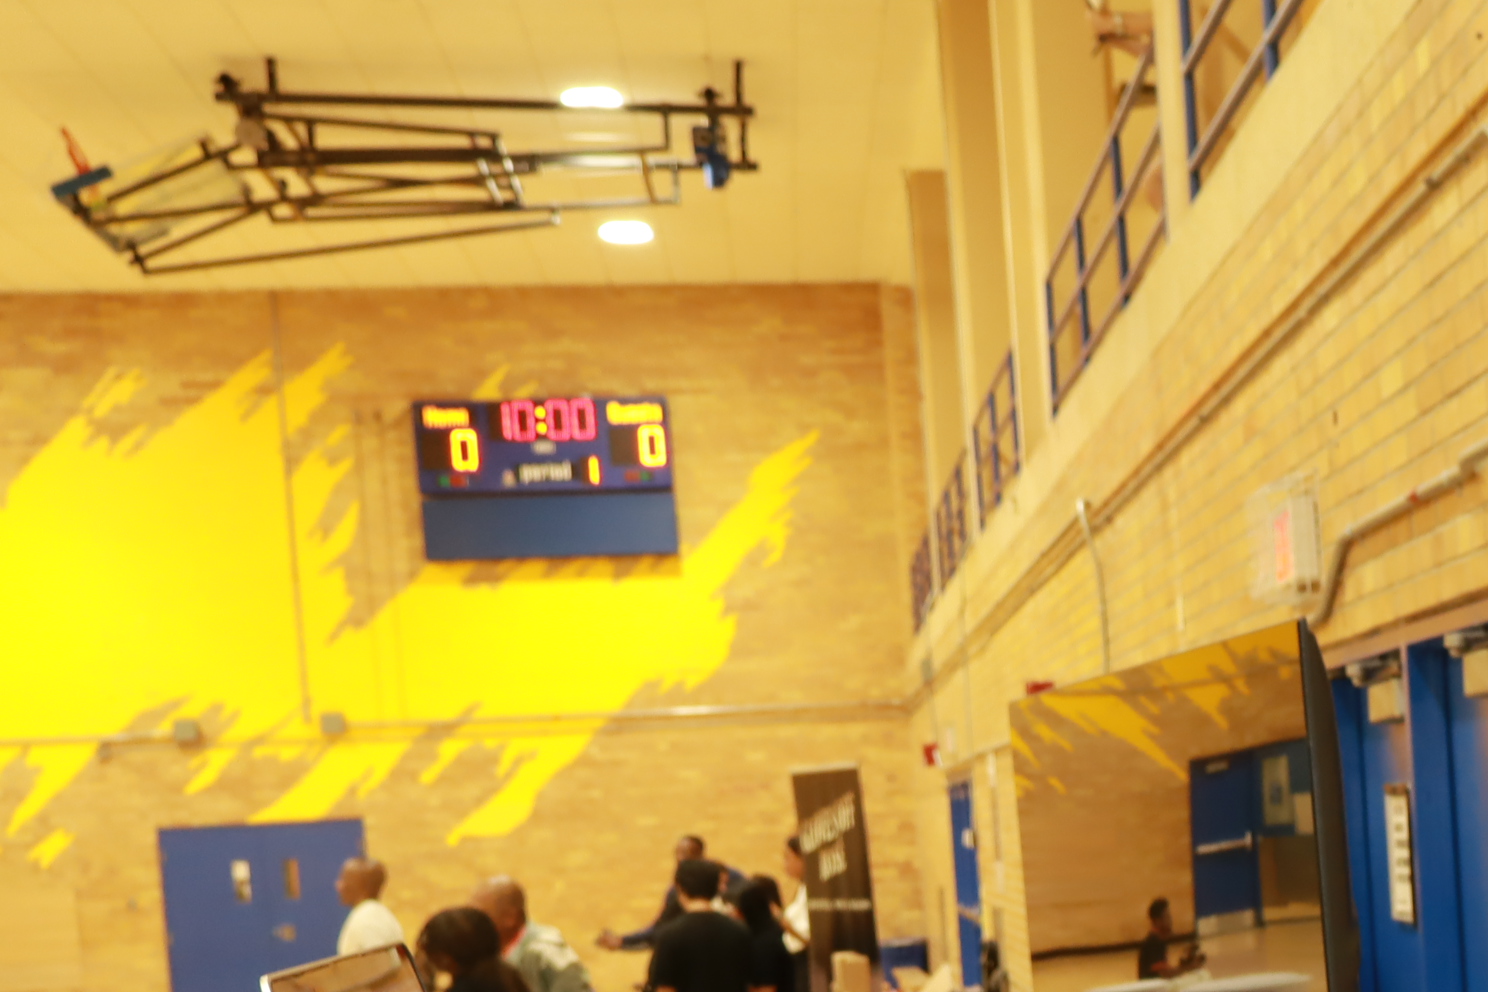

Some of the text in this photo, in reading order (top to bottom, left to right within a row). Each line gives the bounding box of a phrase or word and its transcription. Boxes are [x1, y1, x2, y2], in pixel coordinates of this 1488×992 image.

[500, 398, 599, 442] 10:00
[449, 427, 480, 473] 0
[637, 423, 668, 468] 0
